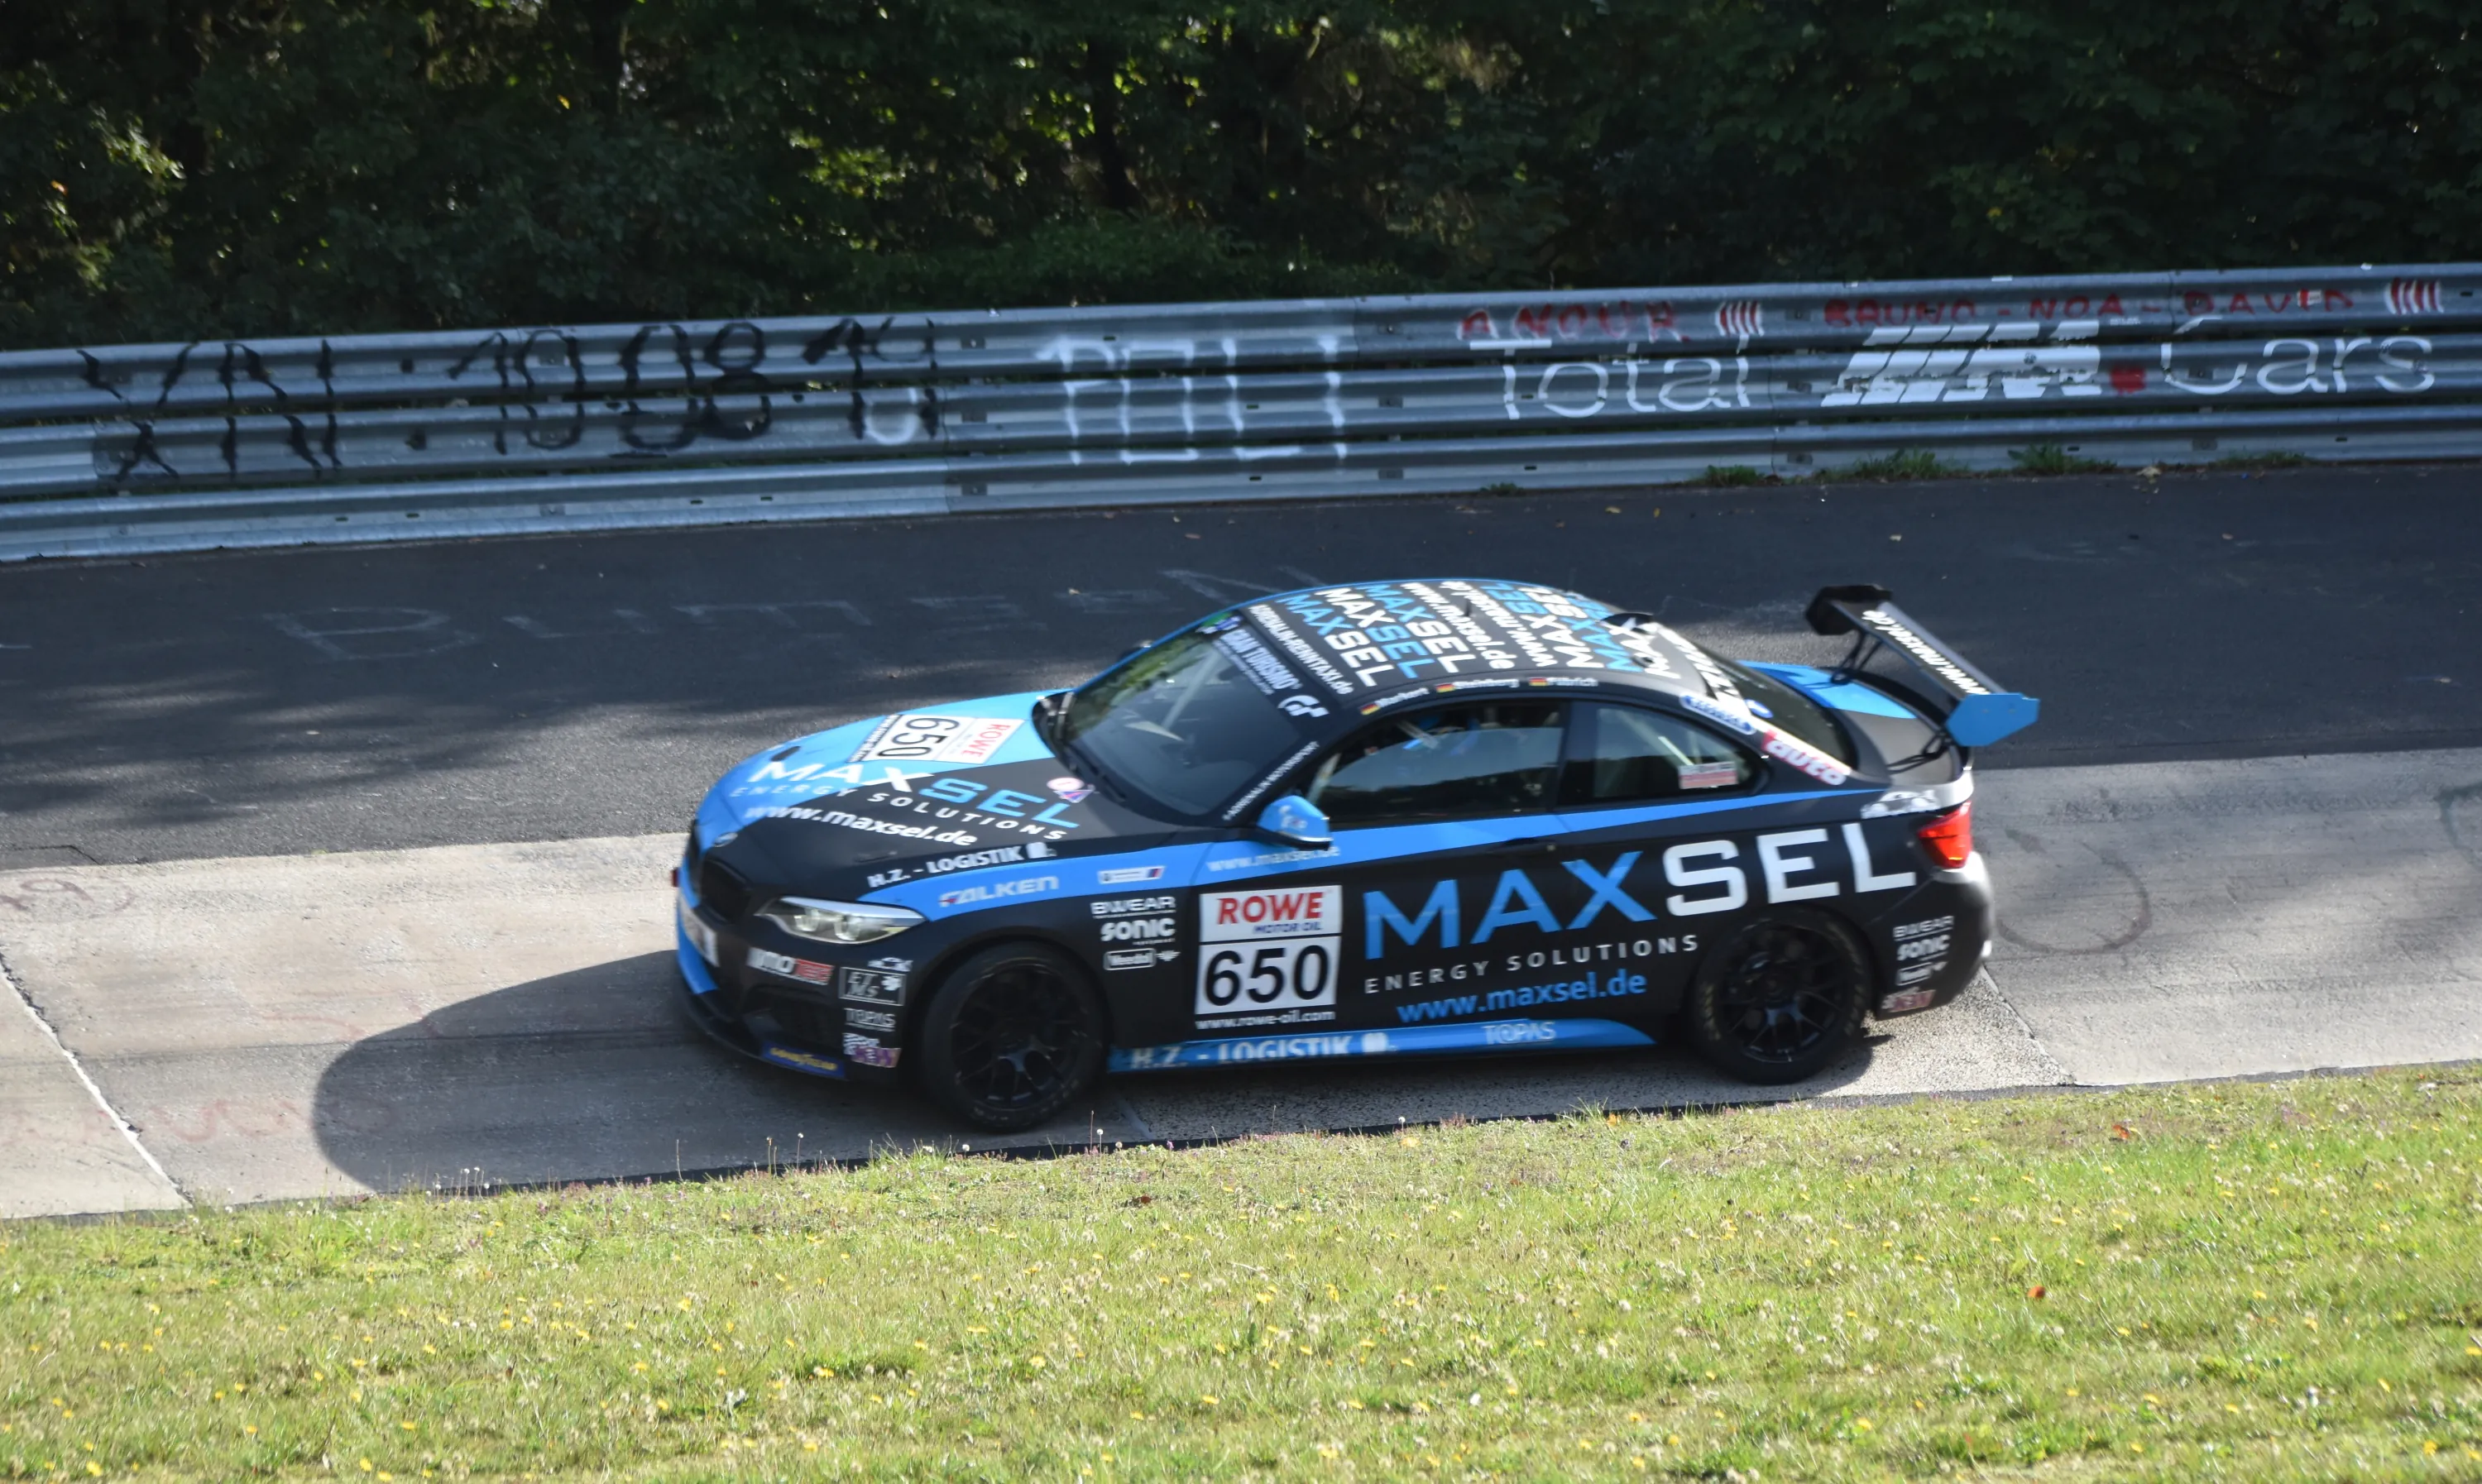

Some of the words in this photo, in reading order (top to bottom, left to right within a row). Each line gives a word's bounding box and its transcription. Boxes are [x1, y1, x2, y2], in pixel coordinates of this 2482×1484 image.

[1469, 333, 1752, 420] Total
[2160, 315, 2436, 395] Cars
[1275, 594, 1395, 687] MAXSEL
[1314, 587, 1435, 678] MAXSEL
[1354, 584, 1477, 673] MAXSEL
[876, 717, 961, 757] 650
[961, 723, 1011, 758] ROWE
[747, 760, 1080, 828] MAXSEL
[867, 792, 1068, 840] SOLUTIONS
[745, 806, 979, 847] www.maxsel.de
[926, 846, 1024, 874] LOGISTIK
[1217, 892, 1325, 925] ROWE
[1363, 822, 1916, 960] MAXSEL
[1253, 922, 1299, 934] MOTOR
[1301, 922, 1323, 931] OIL
[1205, 945, 1330, 1006] 650
[1364, 960, 1489, 994] ENERGY
[1506, 934, 1699, 973] SOLUTIONS
[1195, 1009, 1336, 1030] www.rowe-oil.com
[1397, 969, 1647, 1023] www.maxsel.de
[1218, 1036, 1352, 1065] LOGISTIK
